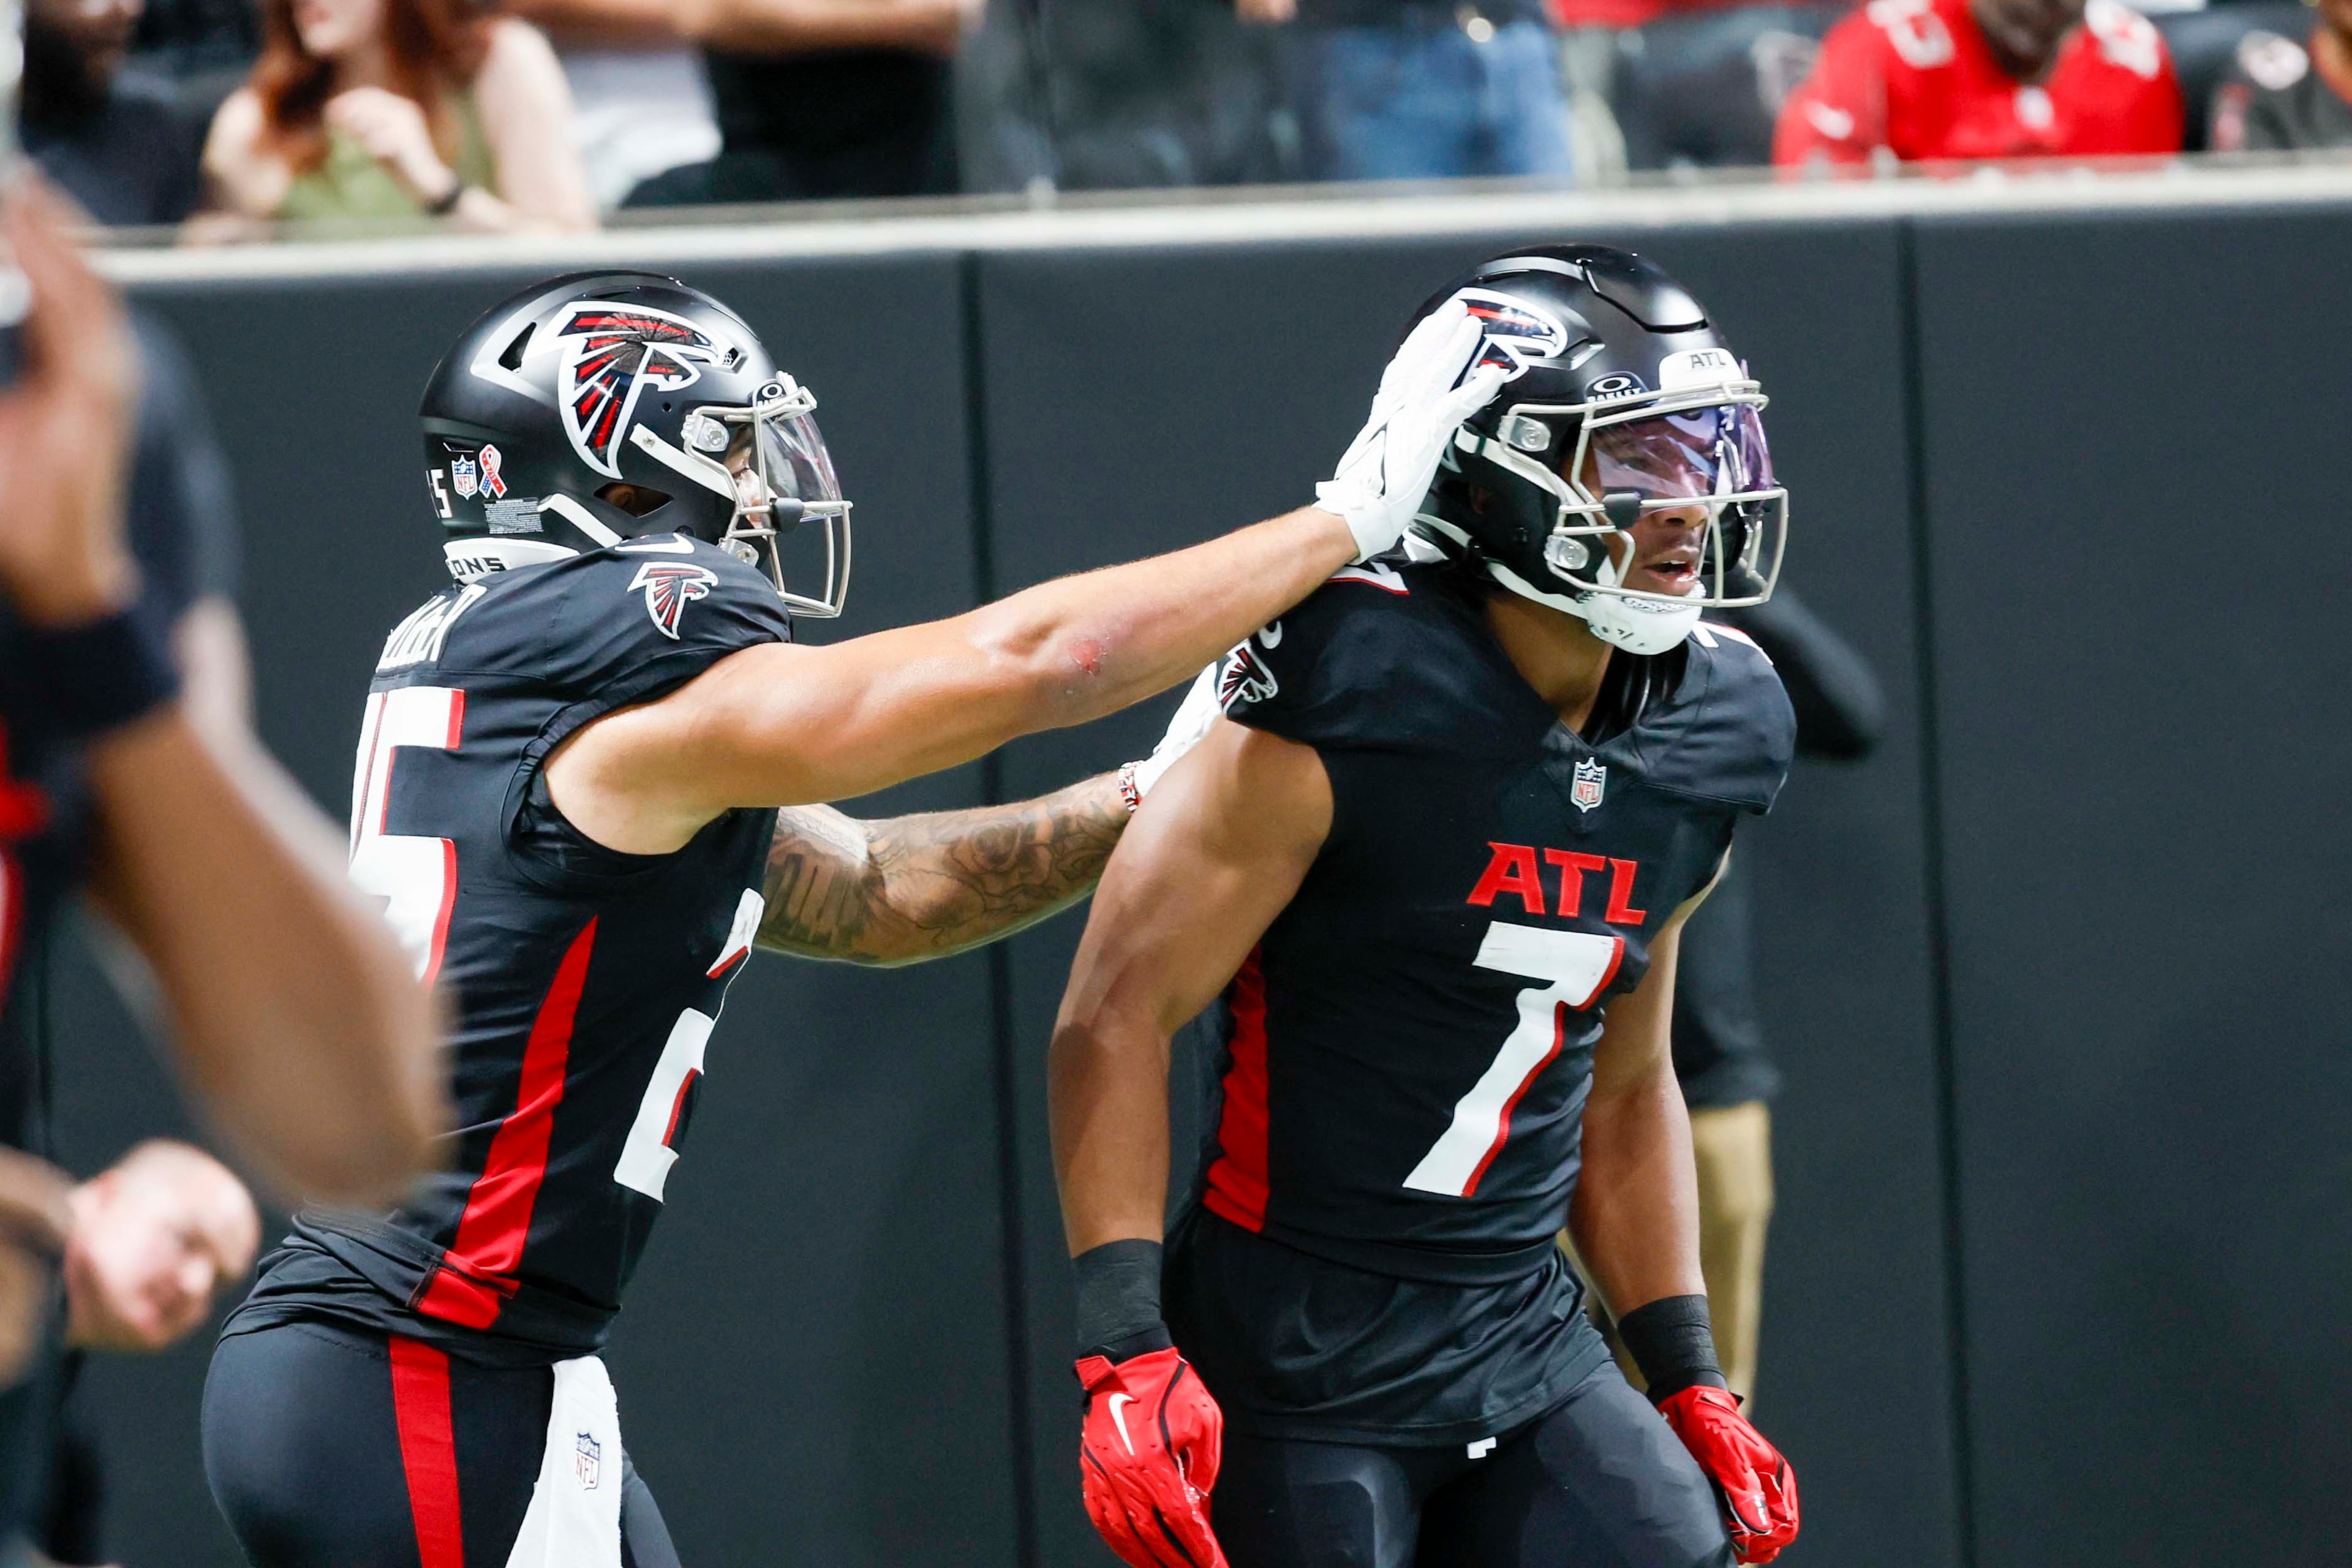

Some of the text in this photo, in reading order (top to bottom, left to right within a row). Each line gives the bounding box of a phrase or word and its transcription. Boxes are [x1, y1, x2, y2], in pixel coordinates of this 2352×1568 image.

[1691, 352, 1726, 369] ATL
[425, 469, 453, 519] 5
[456, 475, 474, 491] NFL
[446, 557, 507, 578] ONS
[1575, 782, 1599, 802] NFL
[348, 685, 466, 989] 5
[1466, 841, 1646, 925] ATL
[1402, 920, 1624, 1197] 7
[576, 1453, 595, 1485] NFL
